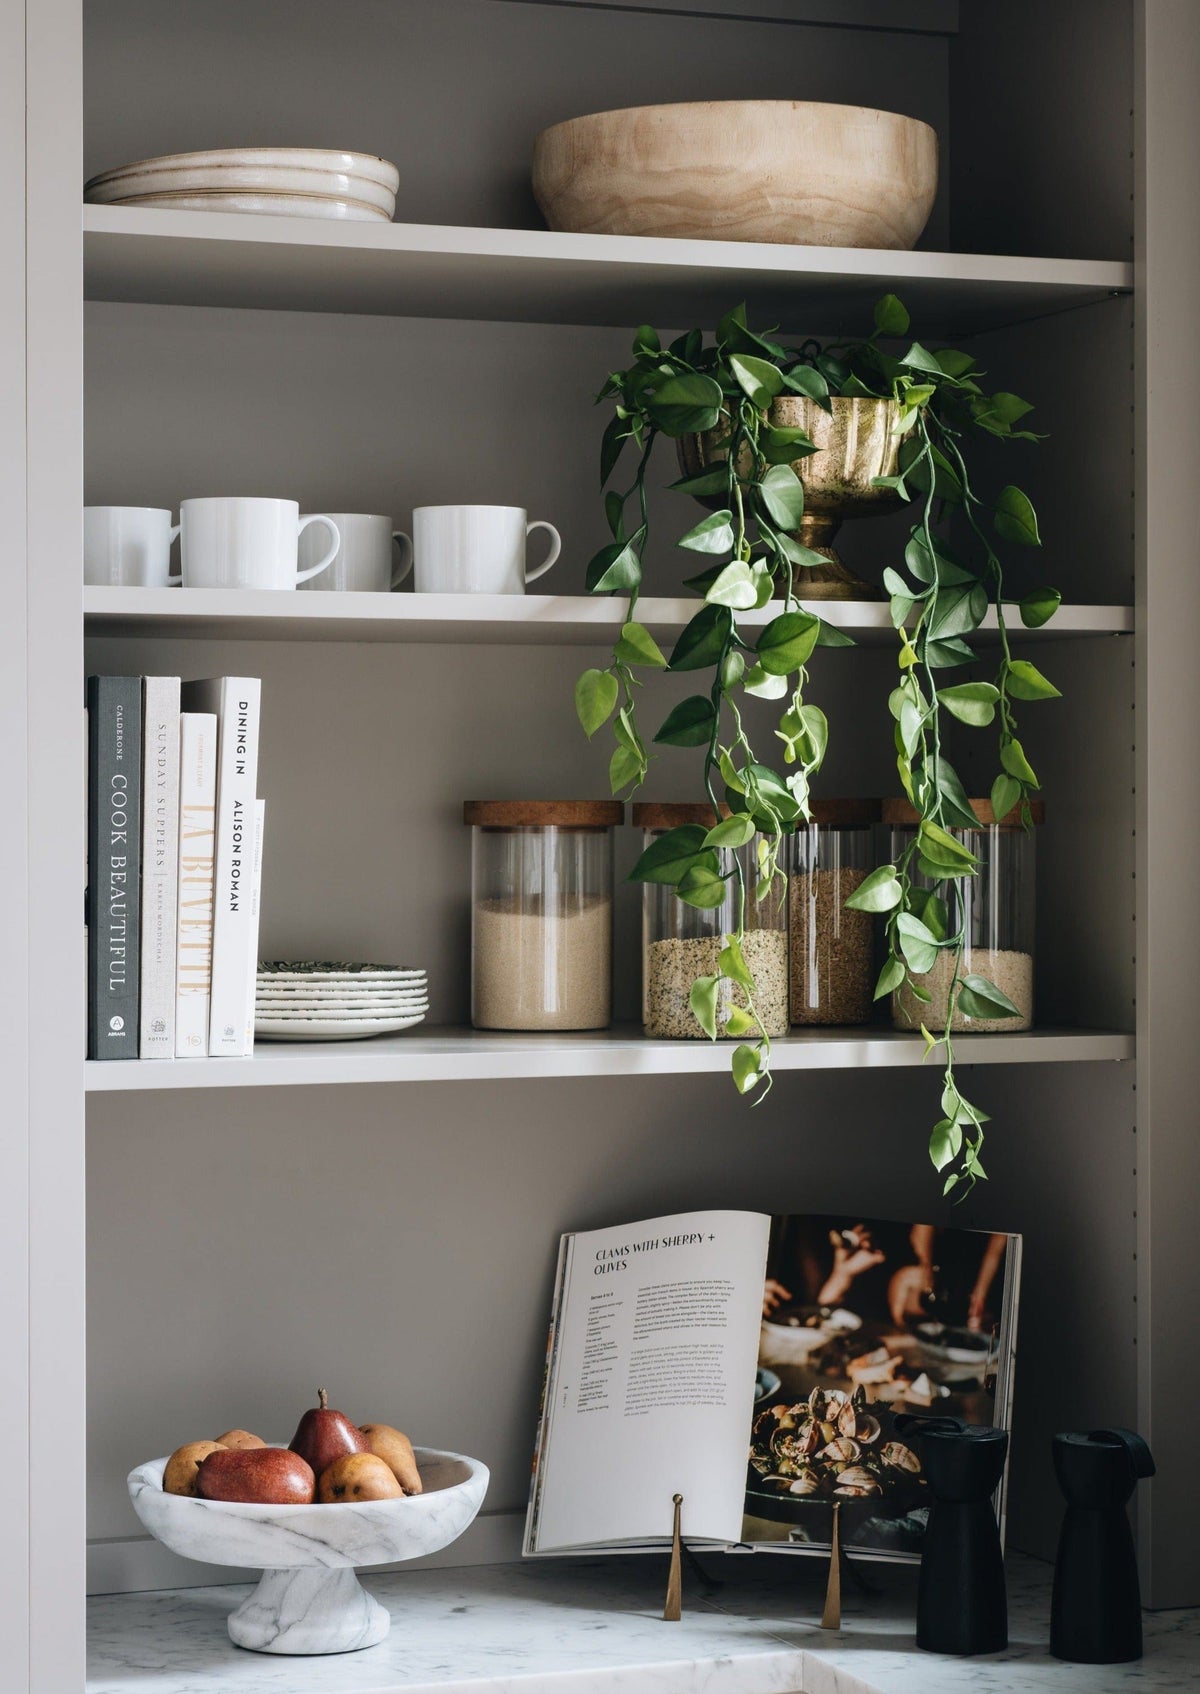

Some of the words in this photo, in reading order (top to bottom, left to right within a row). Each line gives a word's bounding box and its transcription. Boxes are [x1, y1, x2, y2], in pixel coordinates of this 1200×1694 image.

[237, 700, 249, 754] DINING
[157, 724, 166, 789] SUNDAY
[235, 761, 246, 775] IN
[110, 774, 128, 846] COOK
[156, 799, 165, 866] SUPPERS
[182, 805, 215, 839] LA
[231, 800, 243, 853] ALISON
[230, 859, 241, 913] ROMAN
[109, 855, 127, 992] BEAUTIFUL
[178, 856, 214, 997] BUVETTE
[594, 1260, 627, 1276] OLIVES
[595, 1244, 630, 1261] CLAMS
[633, 1238, 659, 1253] WITH
[662, 1233, 705, 1248] SHERRY
